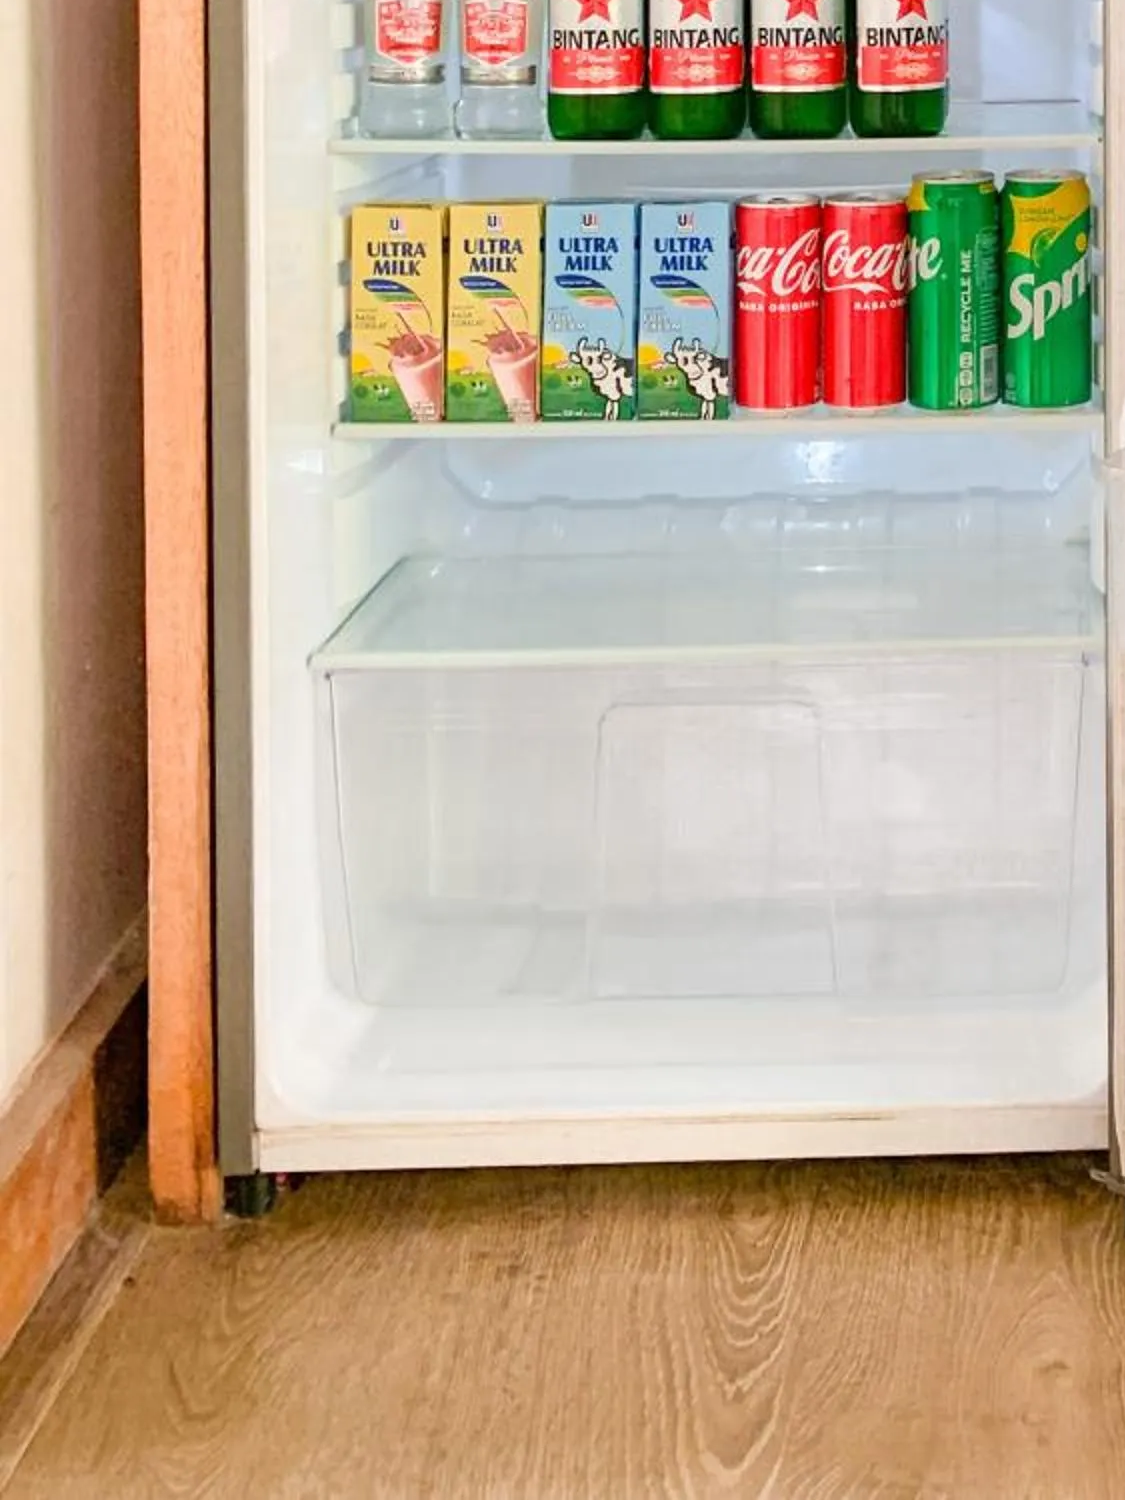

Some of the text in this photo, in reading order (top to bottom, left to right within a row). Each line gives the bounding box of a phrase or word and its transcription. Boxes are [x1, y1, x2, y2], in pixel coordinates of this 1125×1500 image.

[553, 28, 640, 49] BINTANG
[653, 27, 740, 49] BINTANG
[758, 26, 844, 47] BINTANG
[366, 241, 426, 258] ULTRA
[463, 237, 524, 255] ULTRA
[558, 236, 619, 253] ULTRA
[653, 236, 714, 253] ULTRA
[373, 259, 421, 276] MILK
[469, 256, 517, 273] MILK
[564, 254, 613, 271] MILK
[659, 254, 709, 271] MILK
[960, 250, 973, 343] RECYCLE ME
